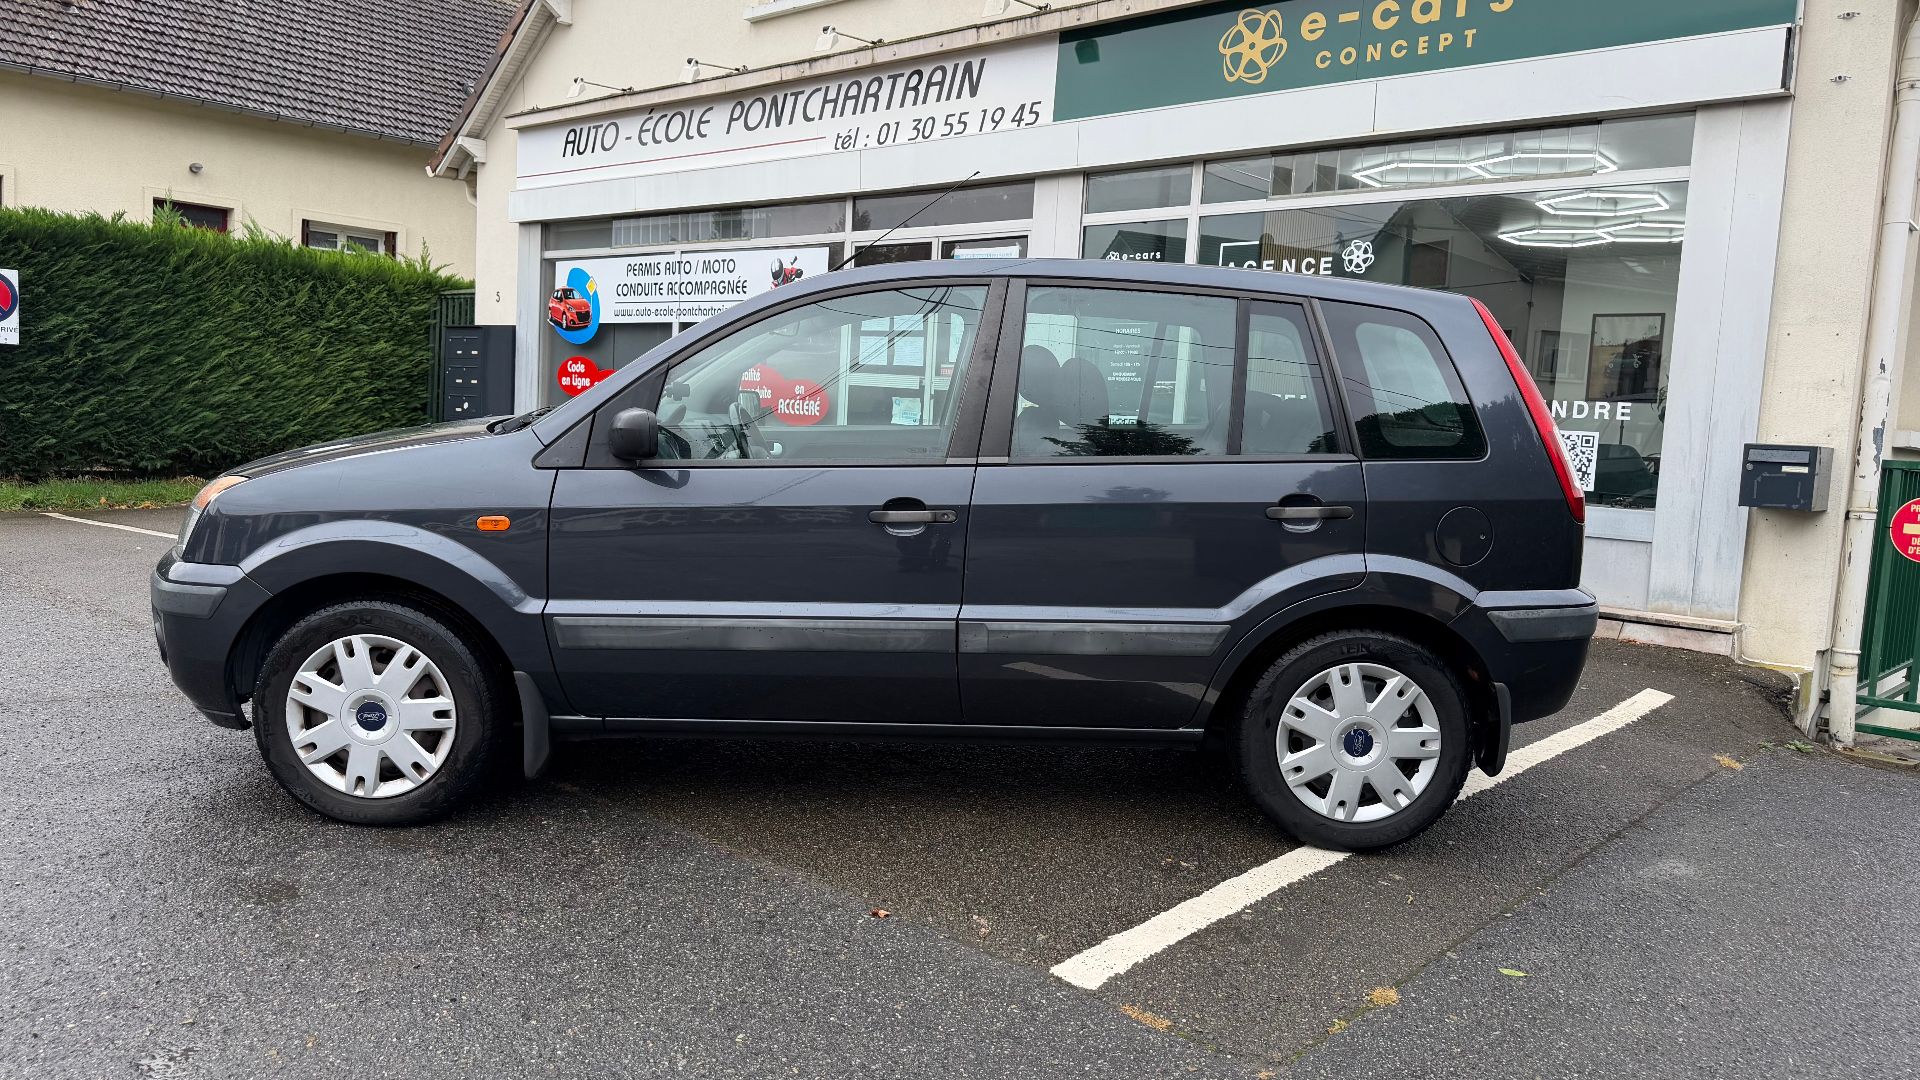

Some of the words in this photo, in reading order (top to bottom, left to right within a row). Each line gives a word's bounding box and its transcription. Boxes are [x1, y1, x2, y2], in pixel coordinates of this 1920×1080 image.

[1315, 29, 1477, 69] CONCEPT
[562, 121, 620, 158] AUTO
[638, 108, 714, 147] ÉCOLE
[726, 58, 987, 135] PONTCHARTRAIN
[834, 127, 860, 151] tél
[877, 121, 901, 146] 01
[907, 116, 936, 142] 30
[940, 111, 970, 138] 55
[978, 106, 1006, 132] 19
[1011, 101, 1042, 127] 45
[626, 261, 661, 277] PERMIS
[664, 260, 692, 276] AUTO
[694, 260, 700, 275] /
[702, 258, 736, 275] MOTO
[495, 290, 501, 303] 5
[616, 281, 664, 297] CONDUITE
[667, 276, 748, 296] ACCOMPAGNÉE
[567, 360, 586, 373] Code
[561, 376, 571, 386] en
[572, 374, 591, 390] Ligne
[794, 384, 805, 395] en
[778, 396, 821, 416] ACCÉLÉRÉ
[1544, 400, 1632, 420] NDRE
